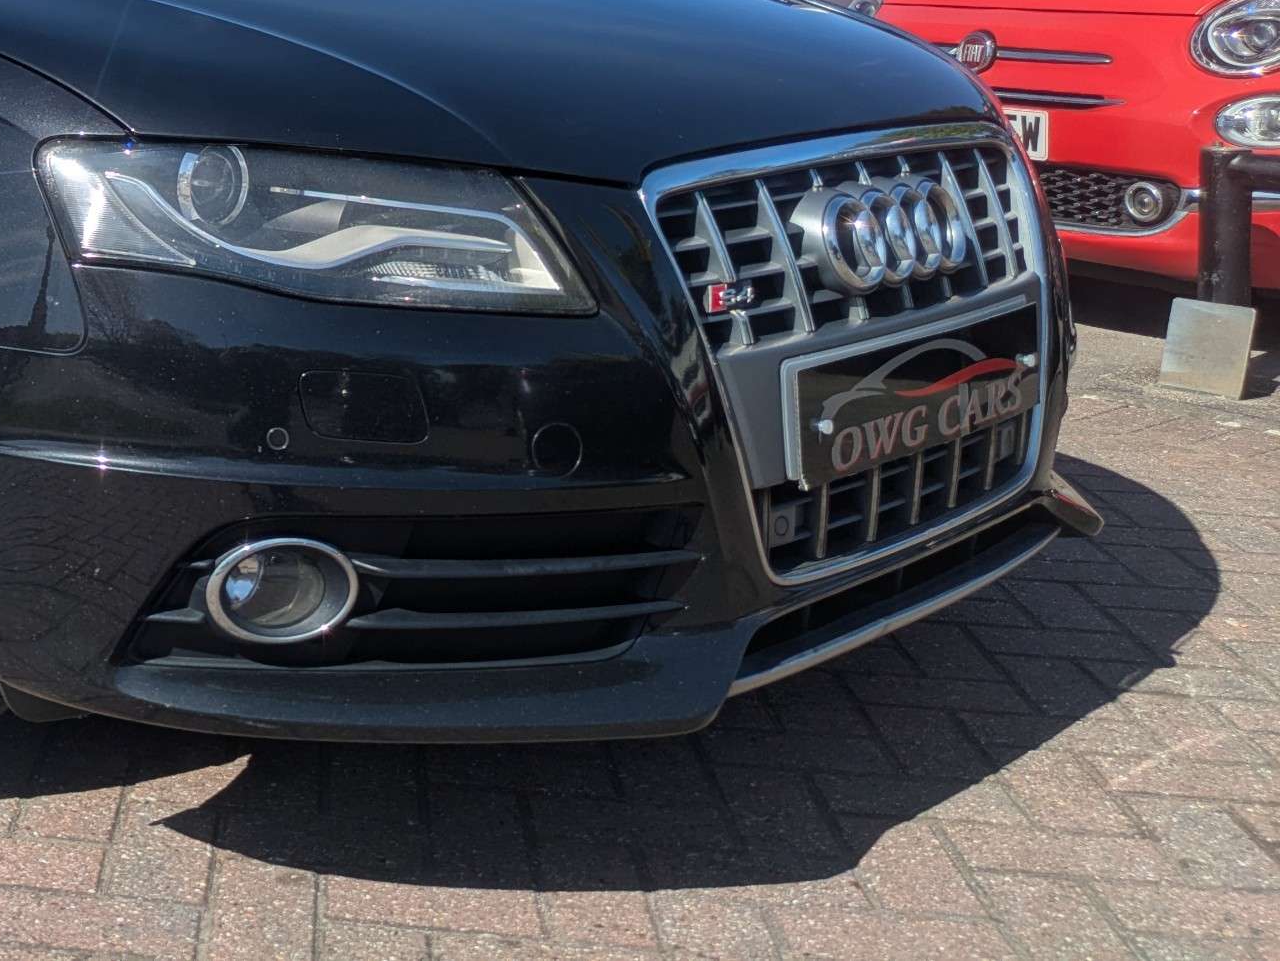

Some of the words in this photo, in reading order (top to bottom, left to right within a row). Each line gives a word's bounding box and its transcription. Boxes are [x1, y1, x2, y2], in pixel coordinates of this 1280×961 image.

[1007, 112, 1041, 152] W
[719, 285, 755, 305] S4
[832, 405, 929, 472] OWG
[937, 373, 1022, 438] CARS
